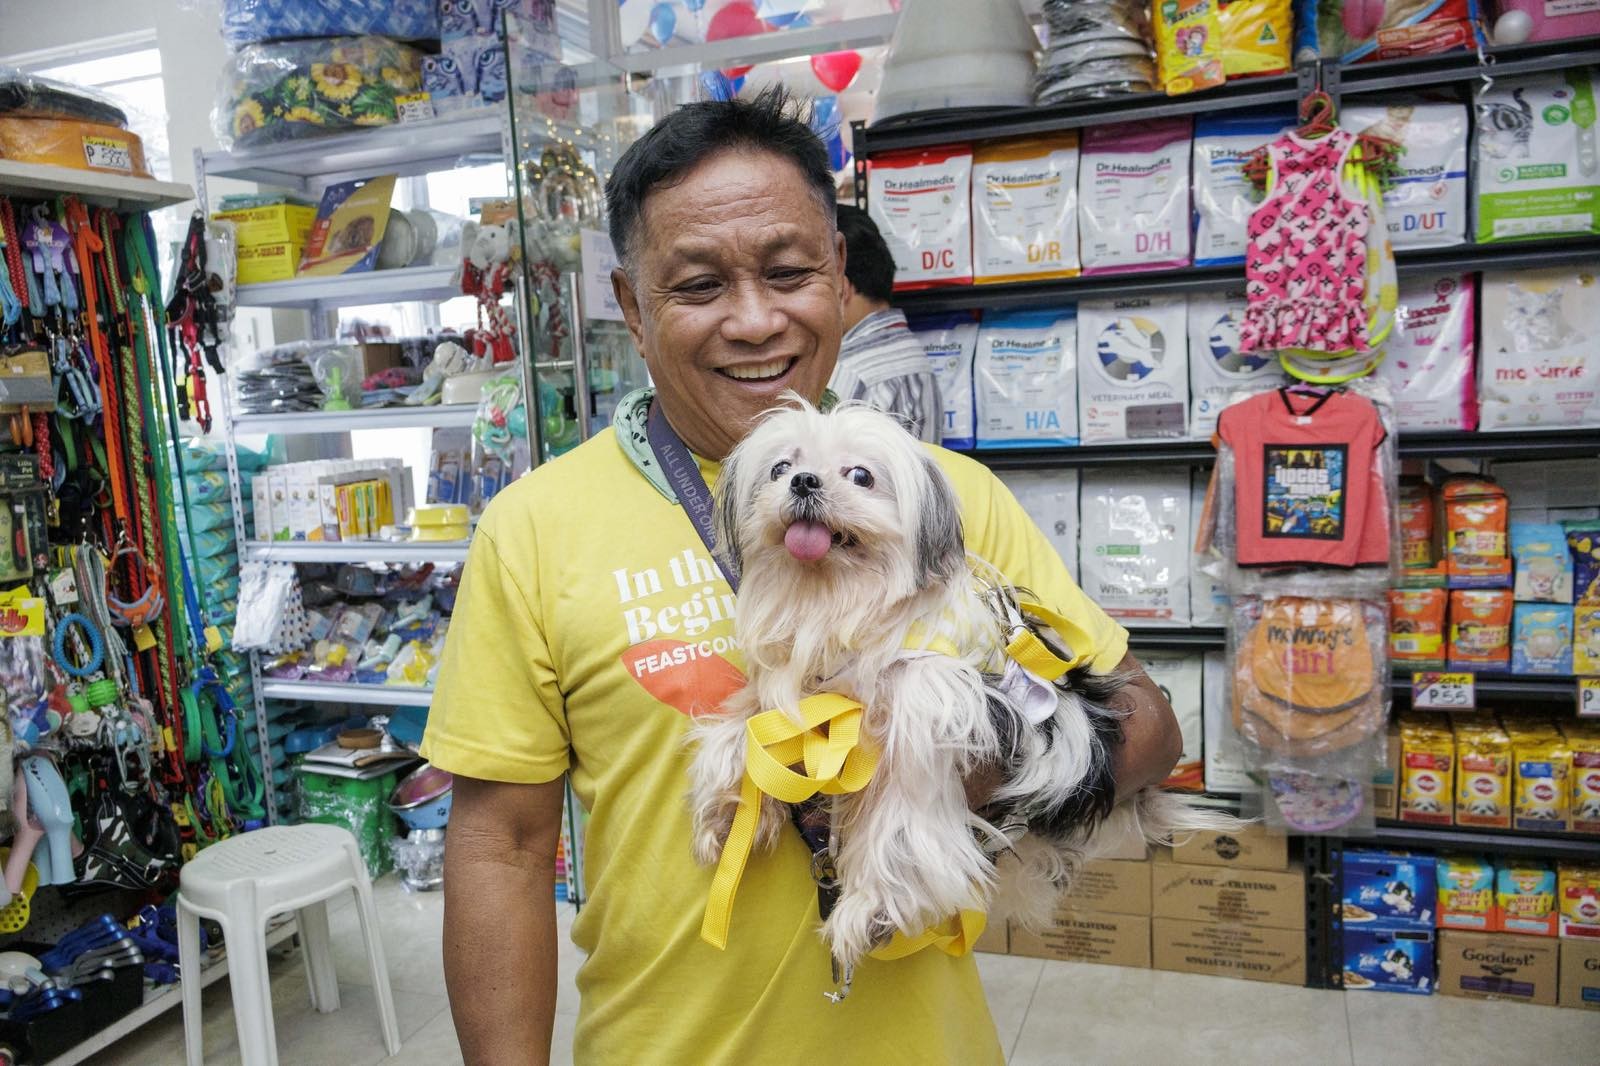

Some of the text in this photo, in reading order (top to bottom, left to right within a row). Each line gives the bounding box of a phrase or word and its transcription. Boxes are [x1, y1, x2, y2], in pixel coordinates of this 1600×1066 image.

[1404, 212, 1446, 231] D/UT
[1027, 240, 1061, 263] D/R
[1135, 231, 1171, 253] D/H
[922, 249, 954, 270] D/C
[1026, 410, 1060, 430] H/A
[661, 444, 678, 469] ALL
[673, 466, 706, 514] UNDER
[612, 567, 664, 605] In
[1282, 647, 1335, 674] Girl
[1462, 948, 1532, 966] Goodest
